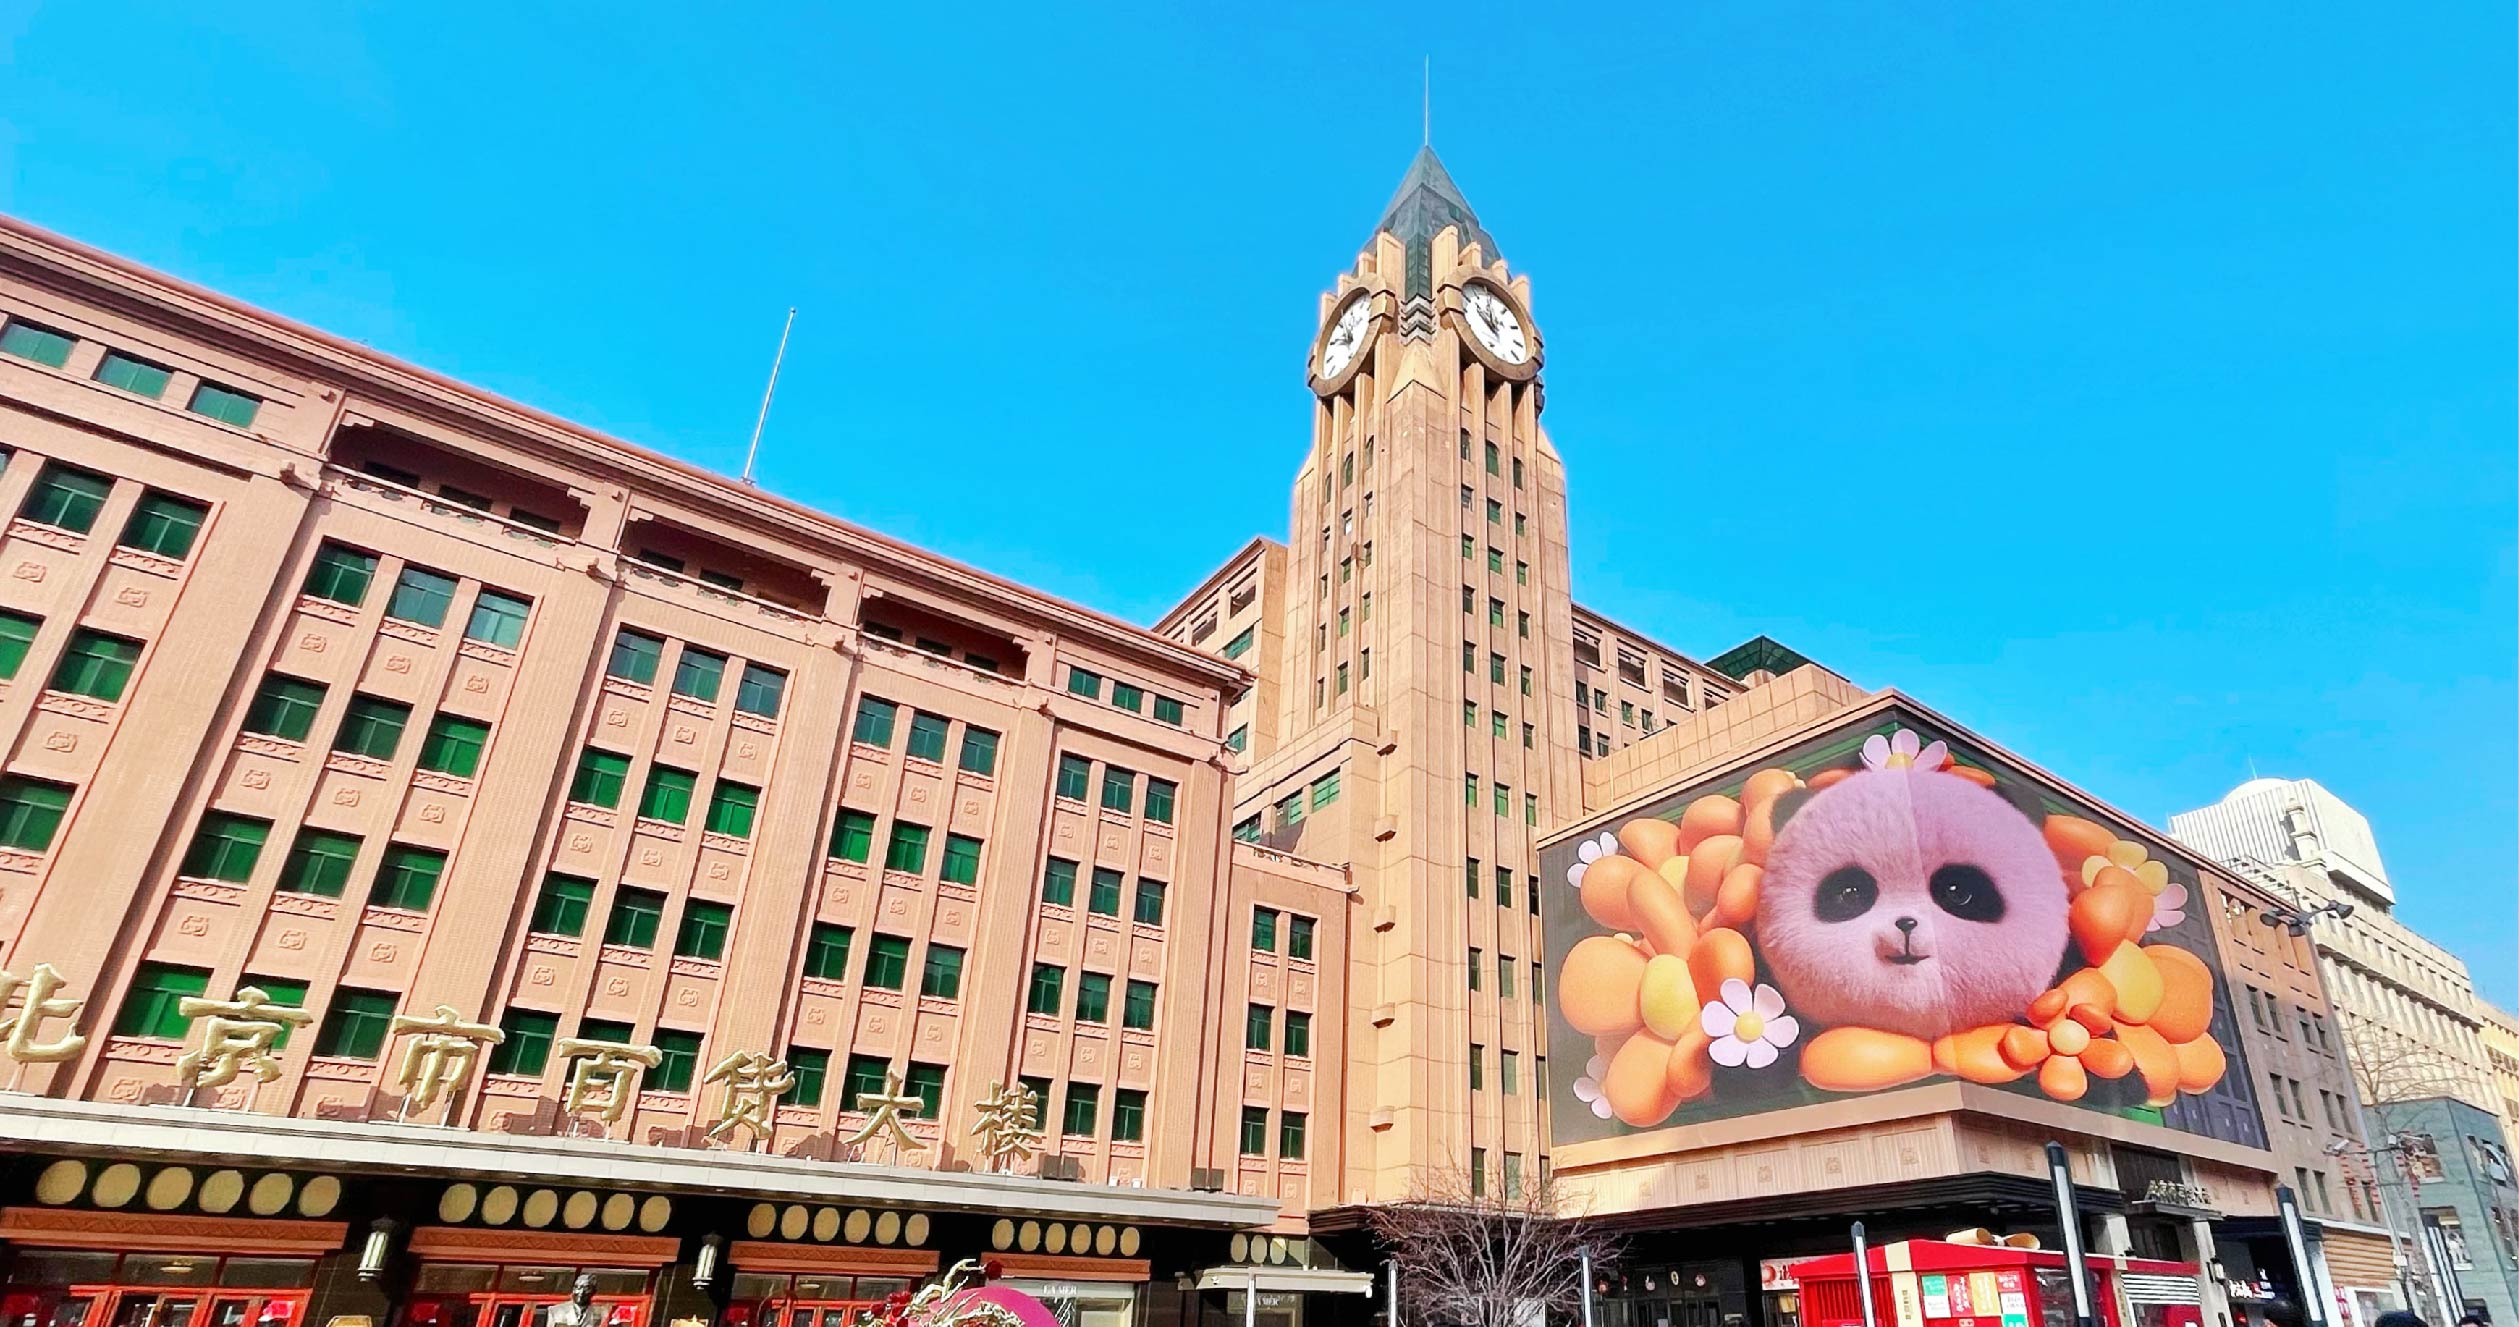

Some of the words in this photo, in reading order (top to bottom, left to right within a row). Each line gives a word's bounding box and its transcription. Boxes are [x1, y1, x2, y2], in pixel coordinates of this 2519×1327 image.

[0, 962, 1042, 1161] 北京市百货大楼
